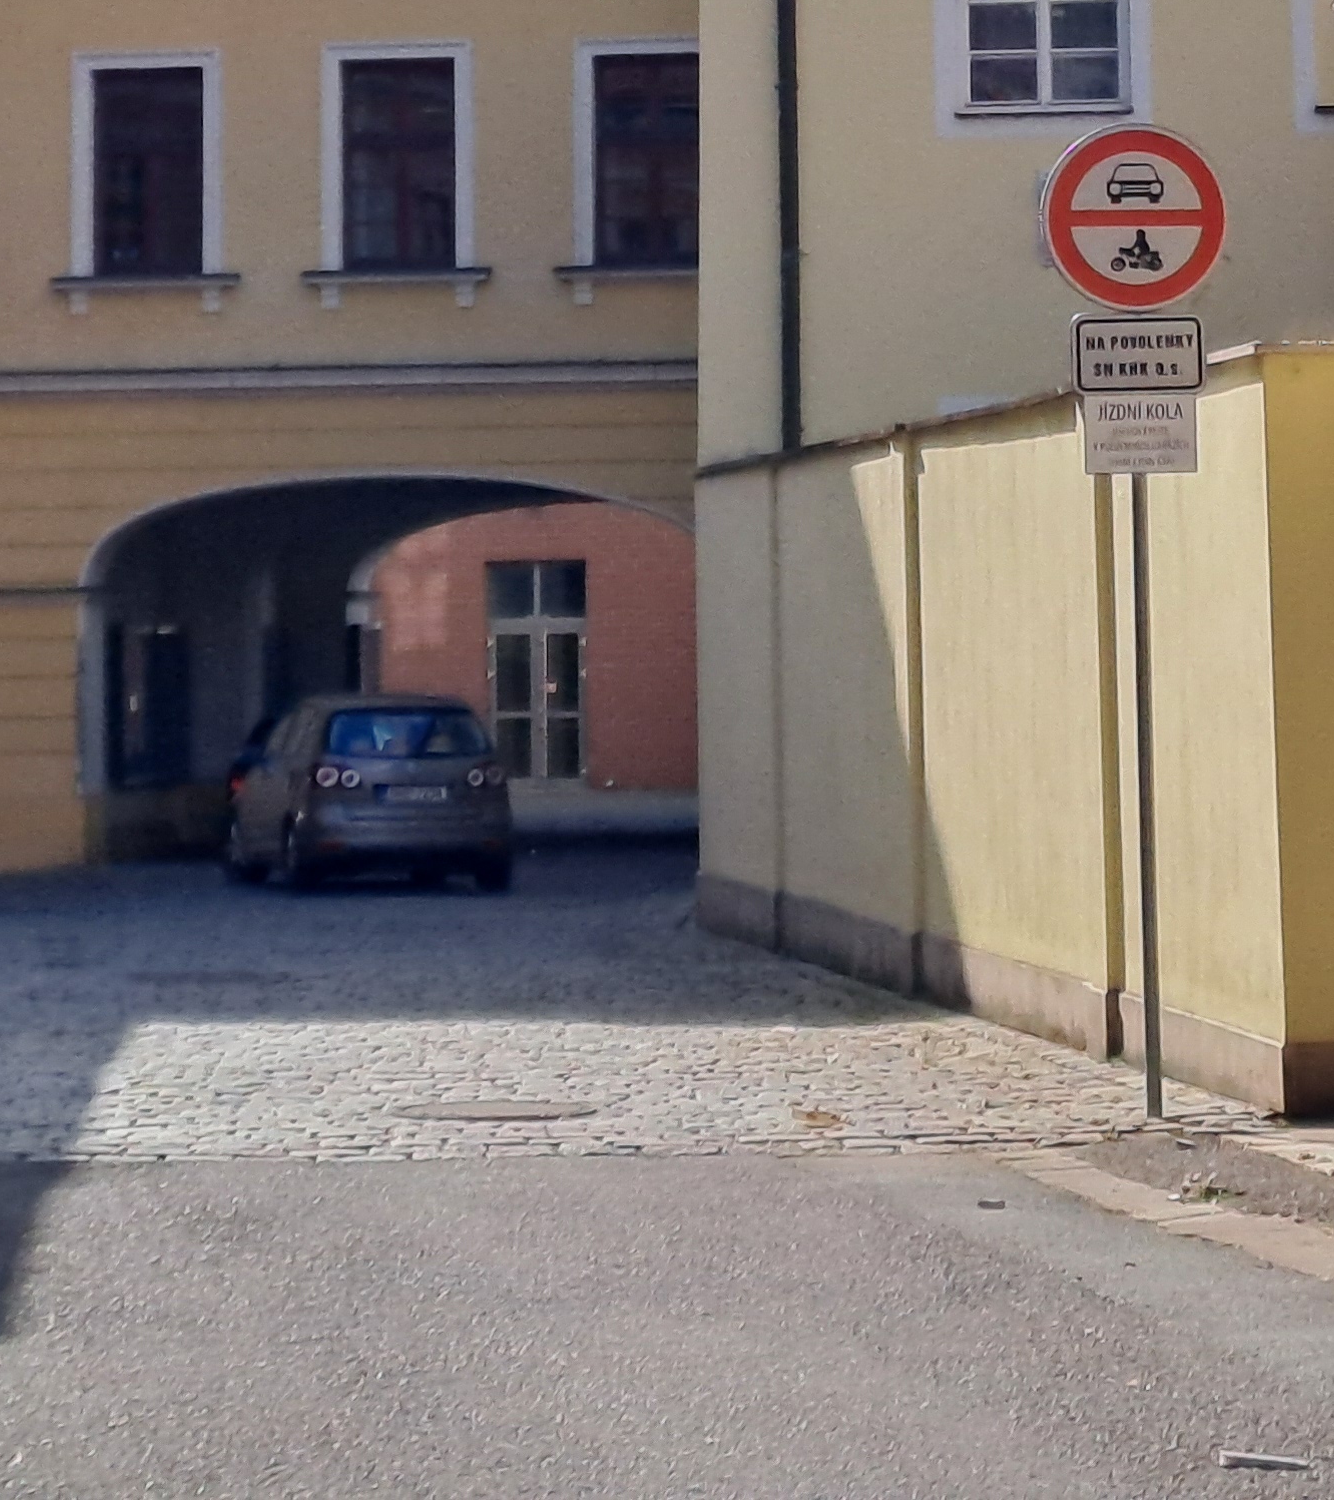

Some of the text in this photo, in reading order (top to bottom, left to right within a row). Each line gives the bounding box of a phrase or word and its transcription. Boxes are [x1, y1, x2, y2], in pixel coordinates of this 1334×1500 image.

[1085, 336, 1105, 351] NA
[1097, 400, 1184, 422] JÍZDNÍ KOLA
